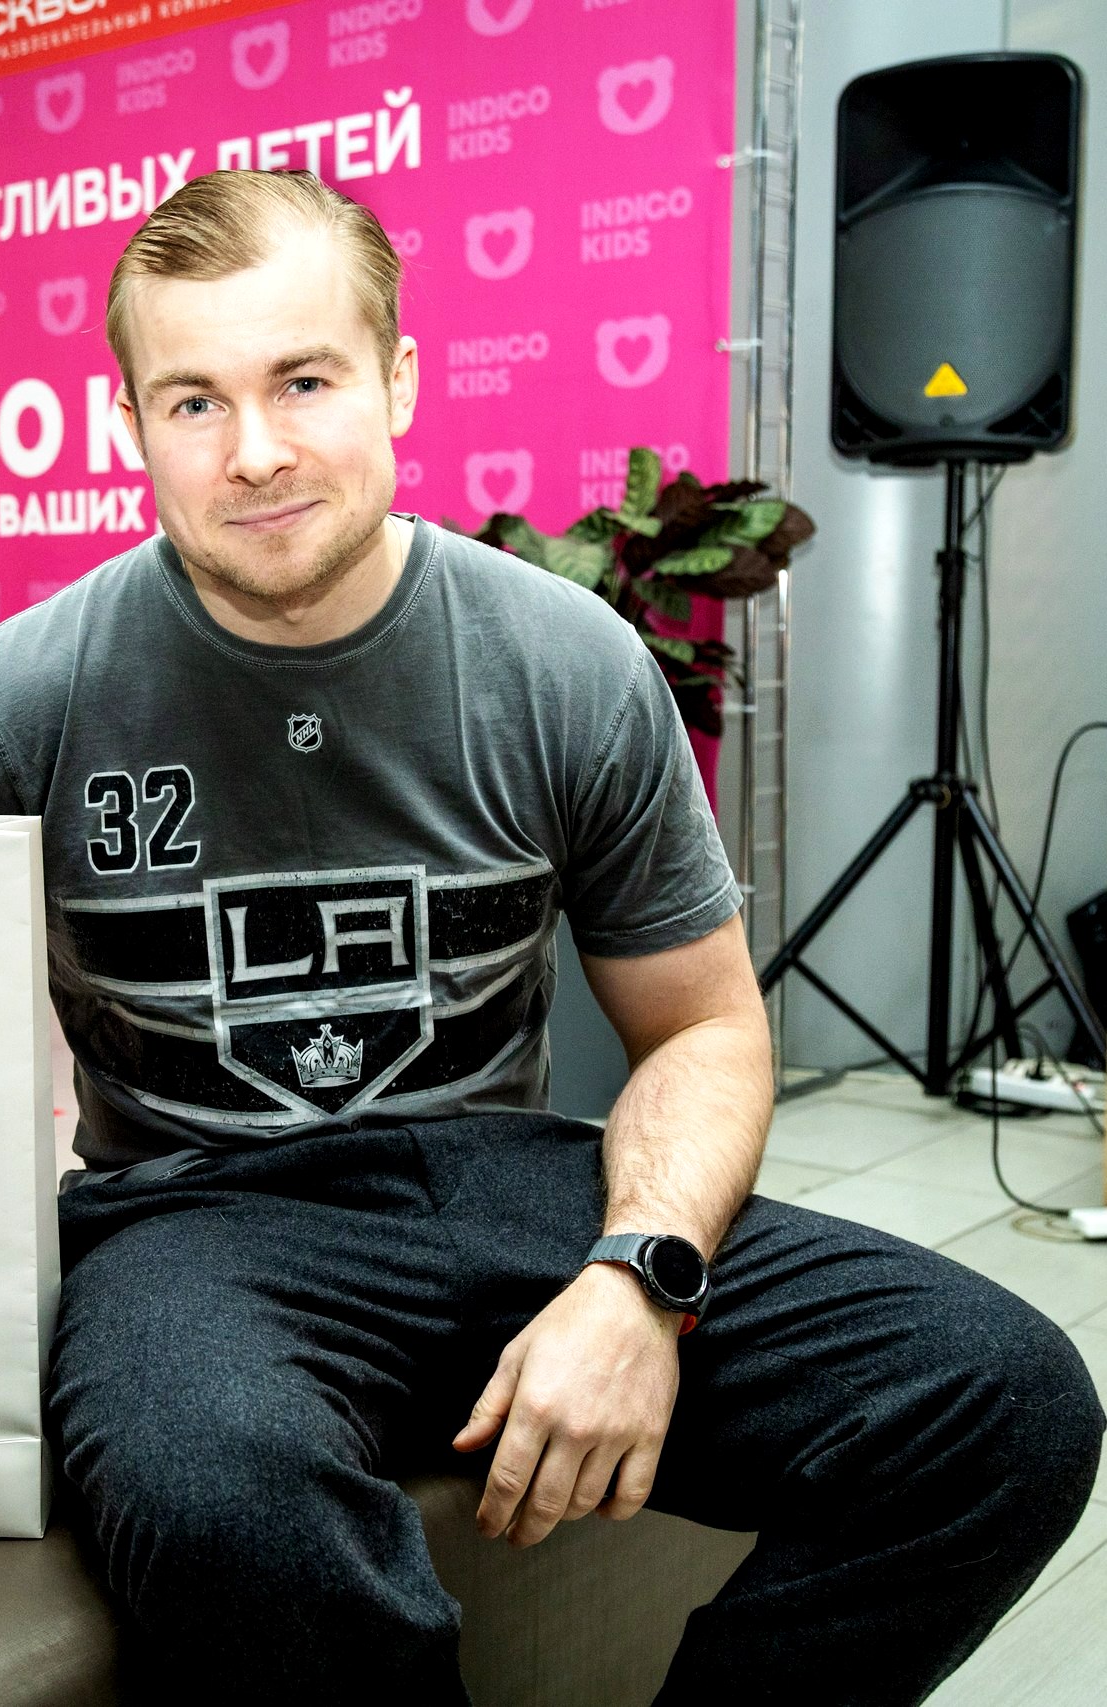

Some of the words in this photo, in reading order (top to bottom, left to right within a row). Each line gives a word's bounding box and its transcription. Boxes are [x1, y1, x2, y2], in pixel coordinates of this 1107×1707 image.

[448, 124, 512, 161] KIDS
[581, 226, 651, 263] KIDS
[448, 366, 512, 398] KIDS
[295, 723, 316, 745] NHL
[85, 764, 201, 875] 32
[225, 896, 410, 983] LA
